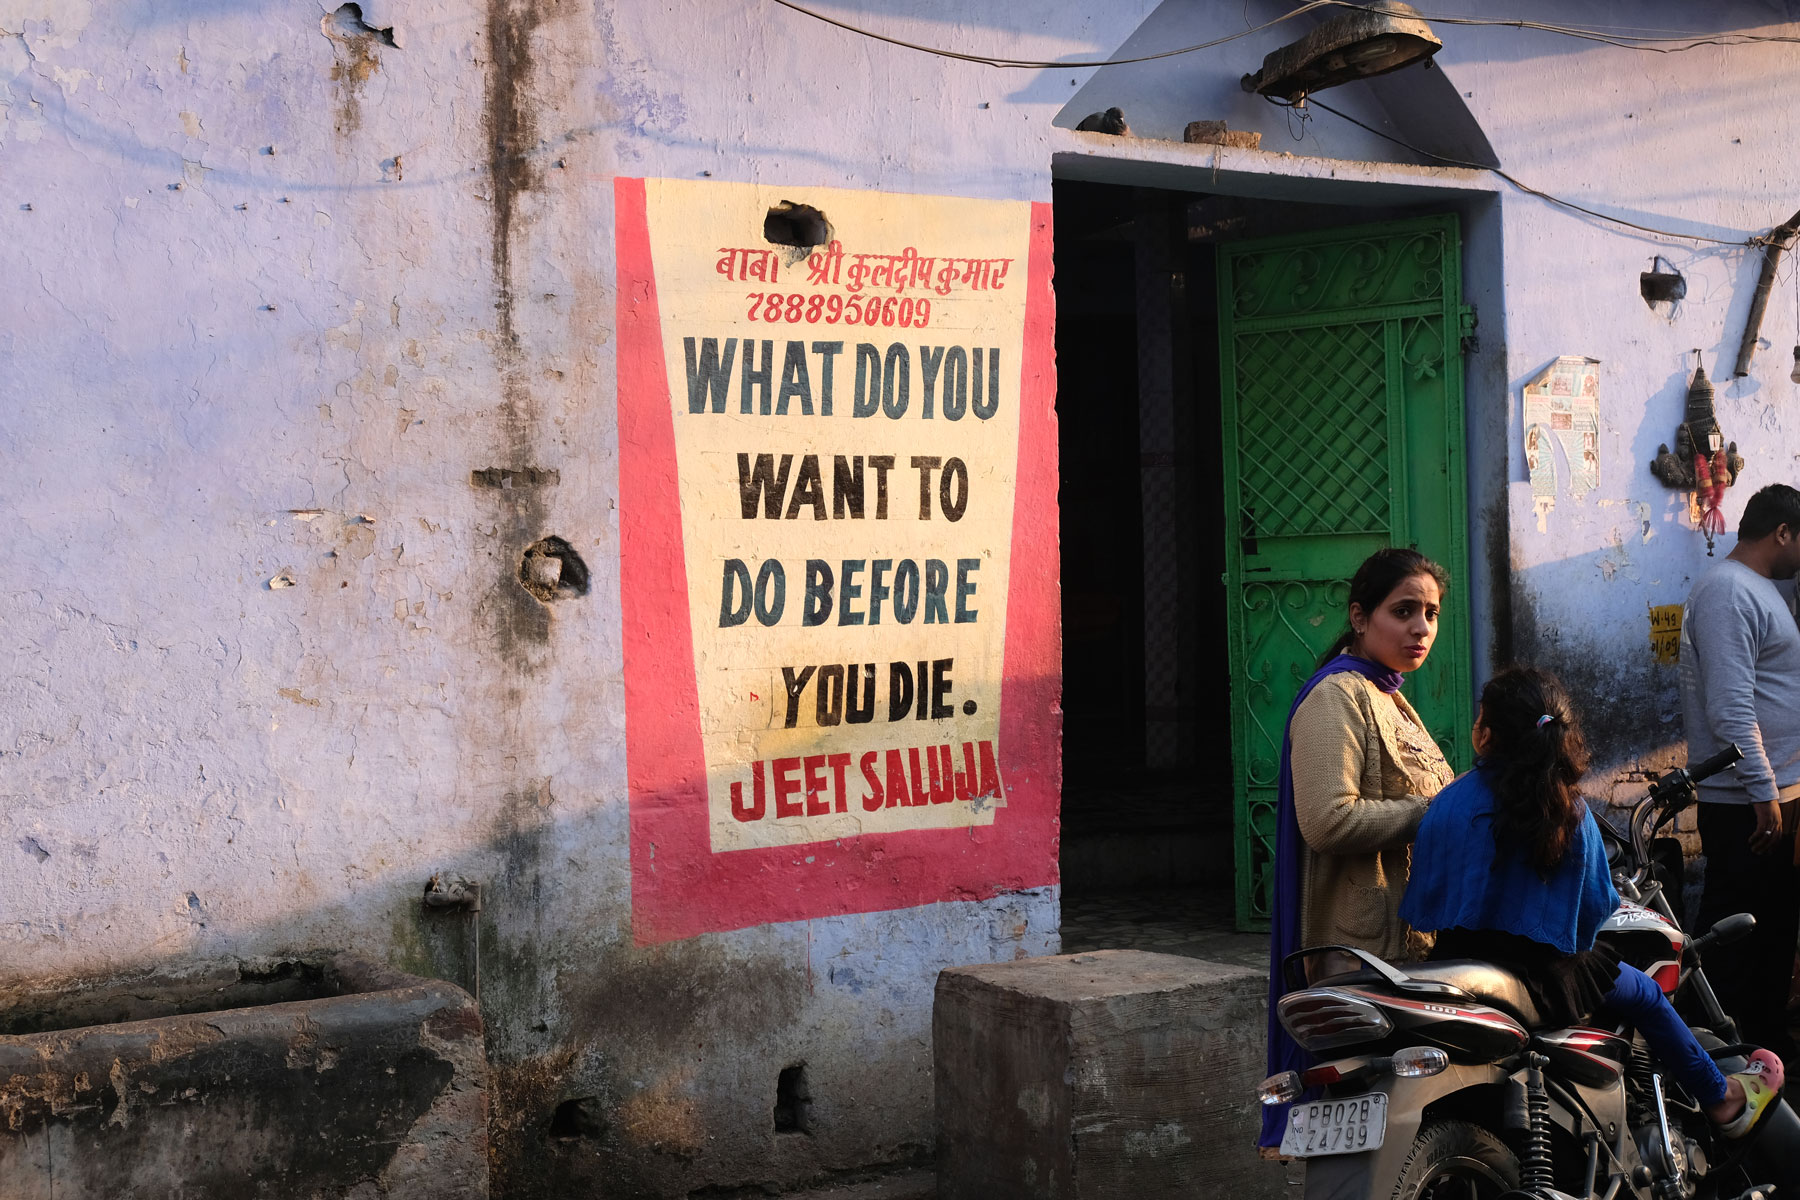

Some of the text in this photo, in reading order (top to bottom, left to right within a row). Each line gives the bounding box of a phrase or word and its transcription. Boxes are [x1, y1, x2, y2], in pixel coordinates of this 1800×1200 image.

[716, 247, 779, 284] बाबा
[807, 239, 847, 285] श्री
[845, 246, 937, 294] कुलदीप
[745, 292, 931, 329] 7888950609
[682, 336, 1001, 422] WHAT DO YOU
[736, 452, 969, 523] WANT TO
[718, 557, 982, 628] DO BEFORE
[781, 657, 978, 729] YOU DIE.
[729, 740, 1003, 823] JEET SALUJA
[1423, 1004, 1457, 1015] 100
[1309, 1100, 1370, 1127] PB02B
